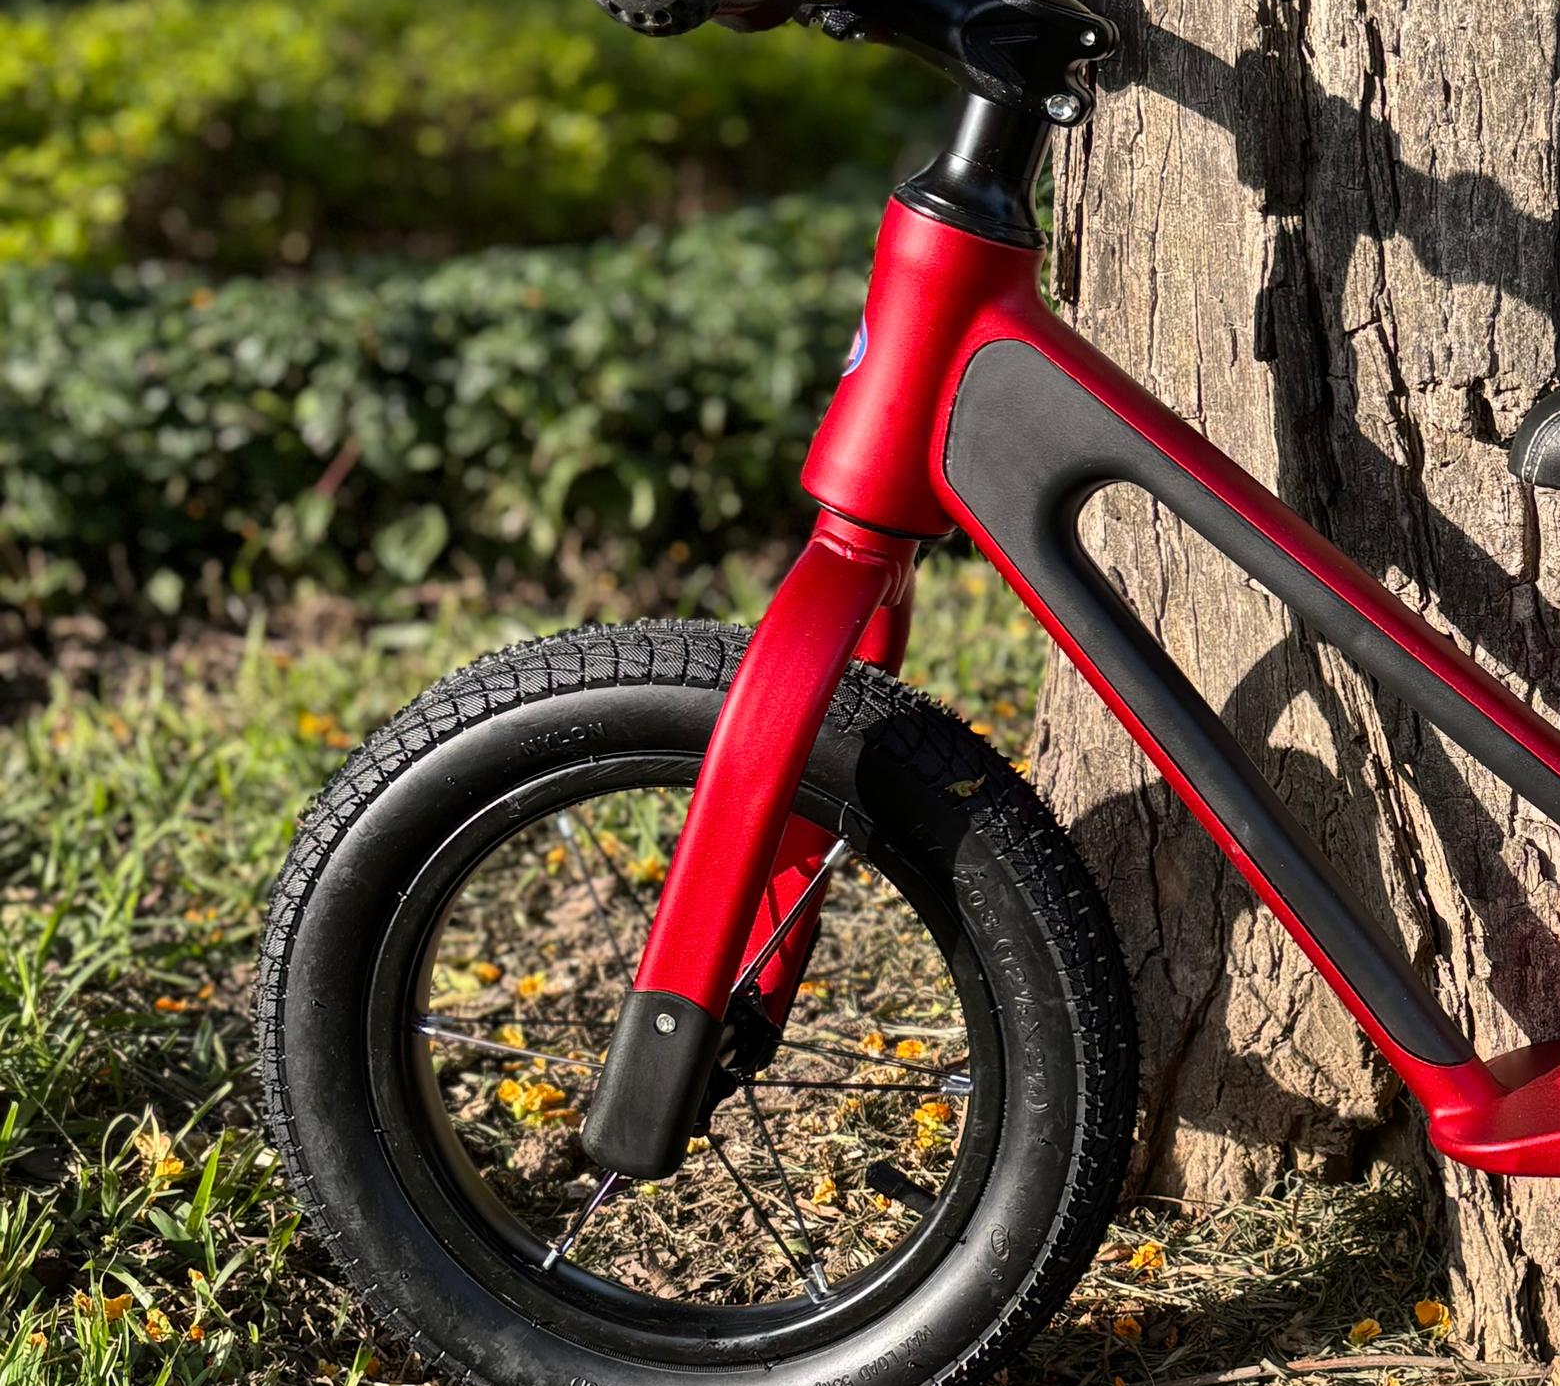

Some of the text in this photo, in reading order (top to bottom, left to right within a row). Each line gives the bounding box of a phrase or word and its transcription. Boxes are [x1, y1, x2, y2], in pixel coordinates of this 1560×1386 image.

[520, 721, 608, 756] NYLON
[898, 1325, 932, 1355] MAX
[858, 1348, 899, 1382] LOAD
